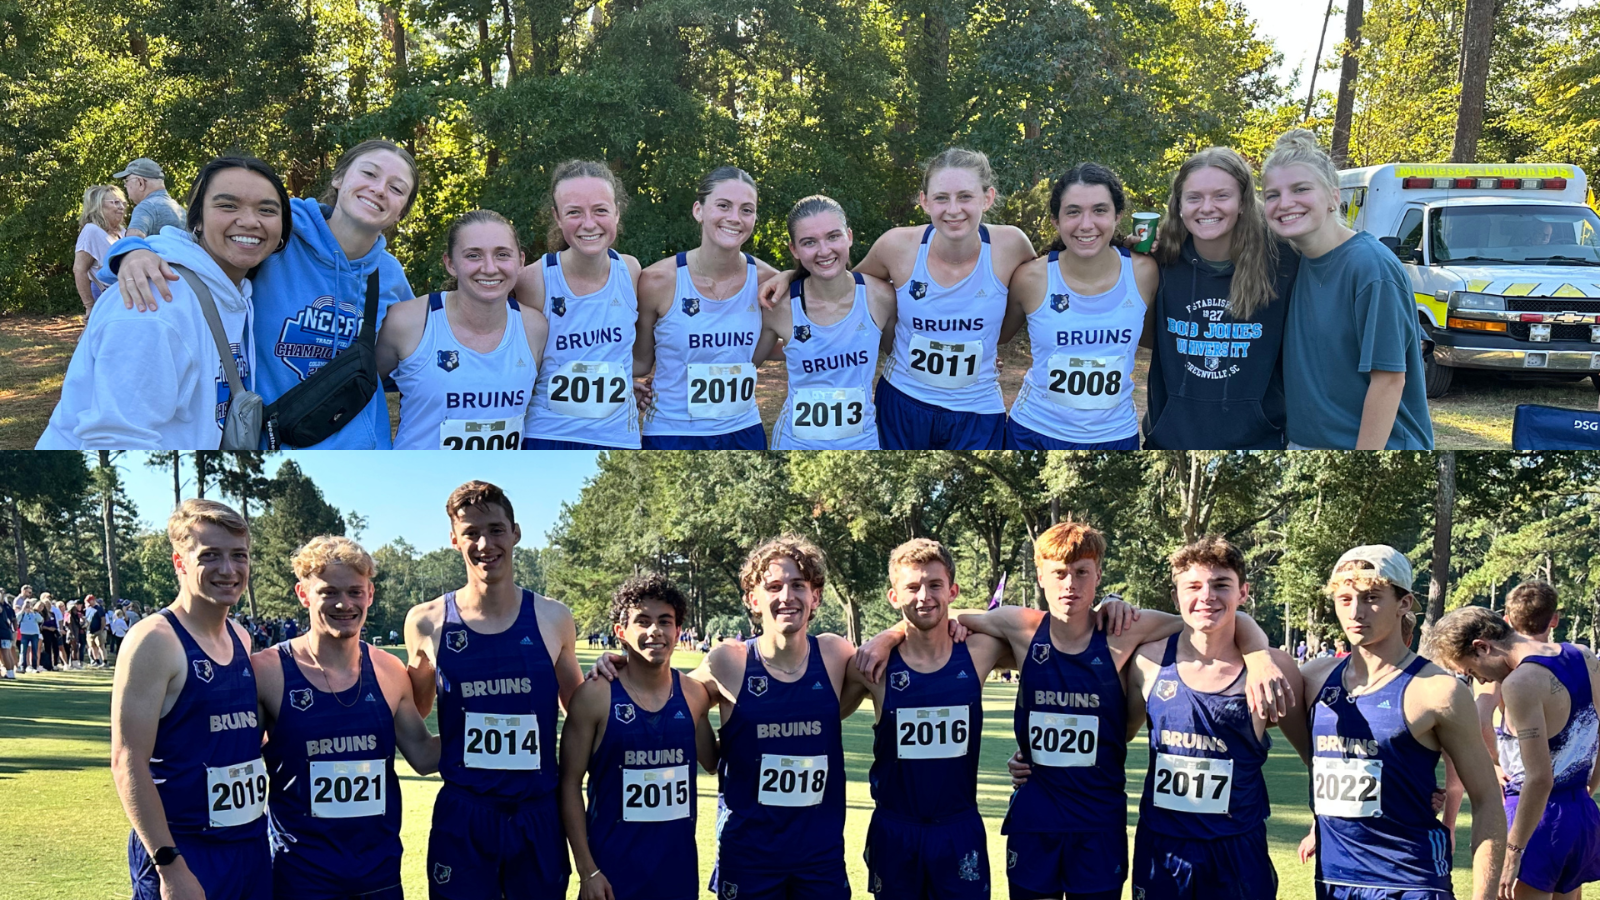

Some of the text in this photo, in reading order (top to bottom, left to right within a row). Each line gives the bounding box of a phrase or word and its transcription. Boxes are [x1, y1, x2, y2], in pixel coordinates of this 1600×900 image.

[1400, 166, 1471, 175] Middlesex
[1485, 166, 1535, 176] London
[1538, 166, 1569, 177] EMS
[912, 317, 984, 332] BRUINS
[1167, 317, 1263, 339] BOB JONES
[556, 327, 622, 350] BRUINS
[688, 331, 754, 348] BRUINS
[1056, 328, 1132, 346] BRUINS
[1176, 337, 1250, 358] UNIVERSITY
[802, 350, 868, 373] BRUINS
[910, 348, 976, 377] 2011
[1229, 364, 1240, 374] SC
[550, 375, 626, 403] 2012
[690, 377, 754, 404] 2010
[1049, 369, 1122, 396] 2008
[446, 390, 525, 409] BRUINS
[794, 401, 863, 427] 2013
[1574, 420, 1598, 430] DSG
[461, 677, 532, 698] BRUINS
[1035, 690, 1100, 708] BRUINS
[466, 727, 538, 755] 2014
[757, 720, 822, 739] BRUINS
[899, 719, 967, 746] 2016
[1030, 726, 1095, 754] 2020
[306, 734, 377, 756] BRUINS
[1161, 730, 1228, 753] BRUINS
[1316, 735, 1378, 757] BRUINS
[624, 749, 684, 765] BRUINS
[314, 774, 381, 803] 2021
[762, 768, 825, 793] 2018
[1156, 768, 1228, 800] 2017
[1316, 772, 1378, 802] 2022
[212, 774, 267, 812] 2019
[625, 780, 688, 808] 2015
